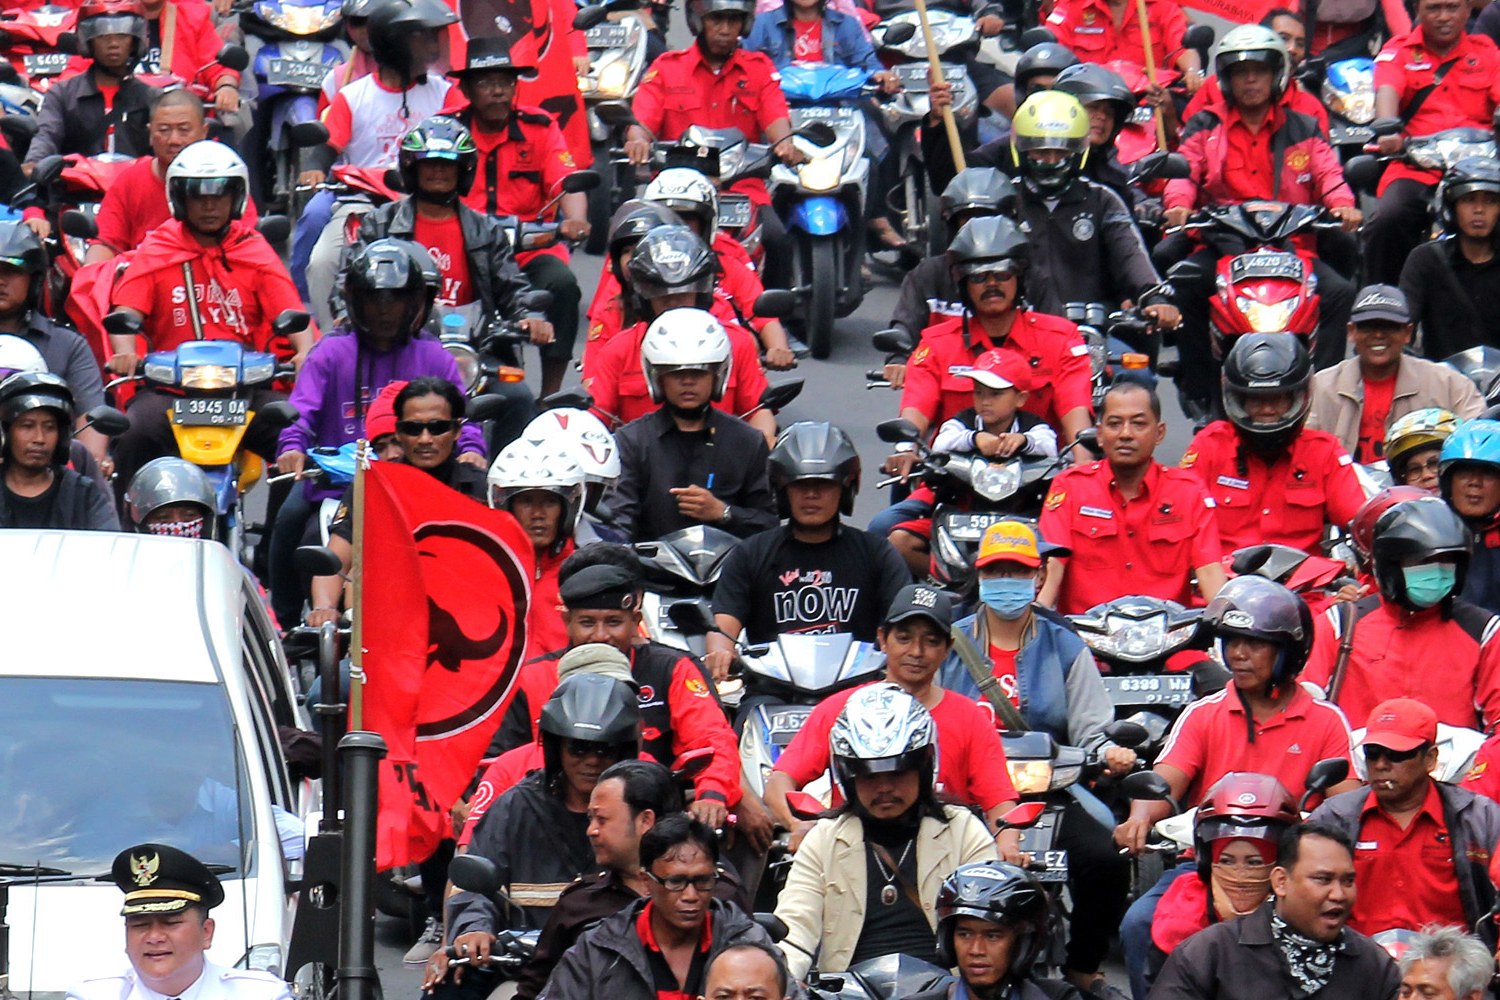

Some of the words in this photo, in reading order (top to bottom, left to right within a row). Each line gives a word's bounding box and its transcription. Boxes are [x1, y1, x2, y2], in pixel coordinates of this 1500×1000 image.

[174, 403, 183, 415] L
[188, 401, 222, 414] 3945
[774, 590, 860, 623] now
[1168, 678, 1192, 691] WW
[1045, 852, 1068, 868] EZ
